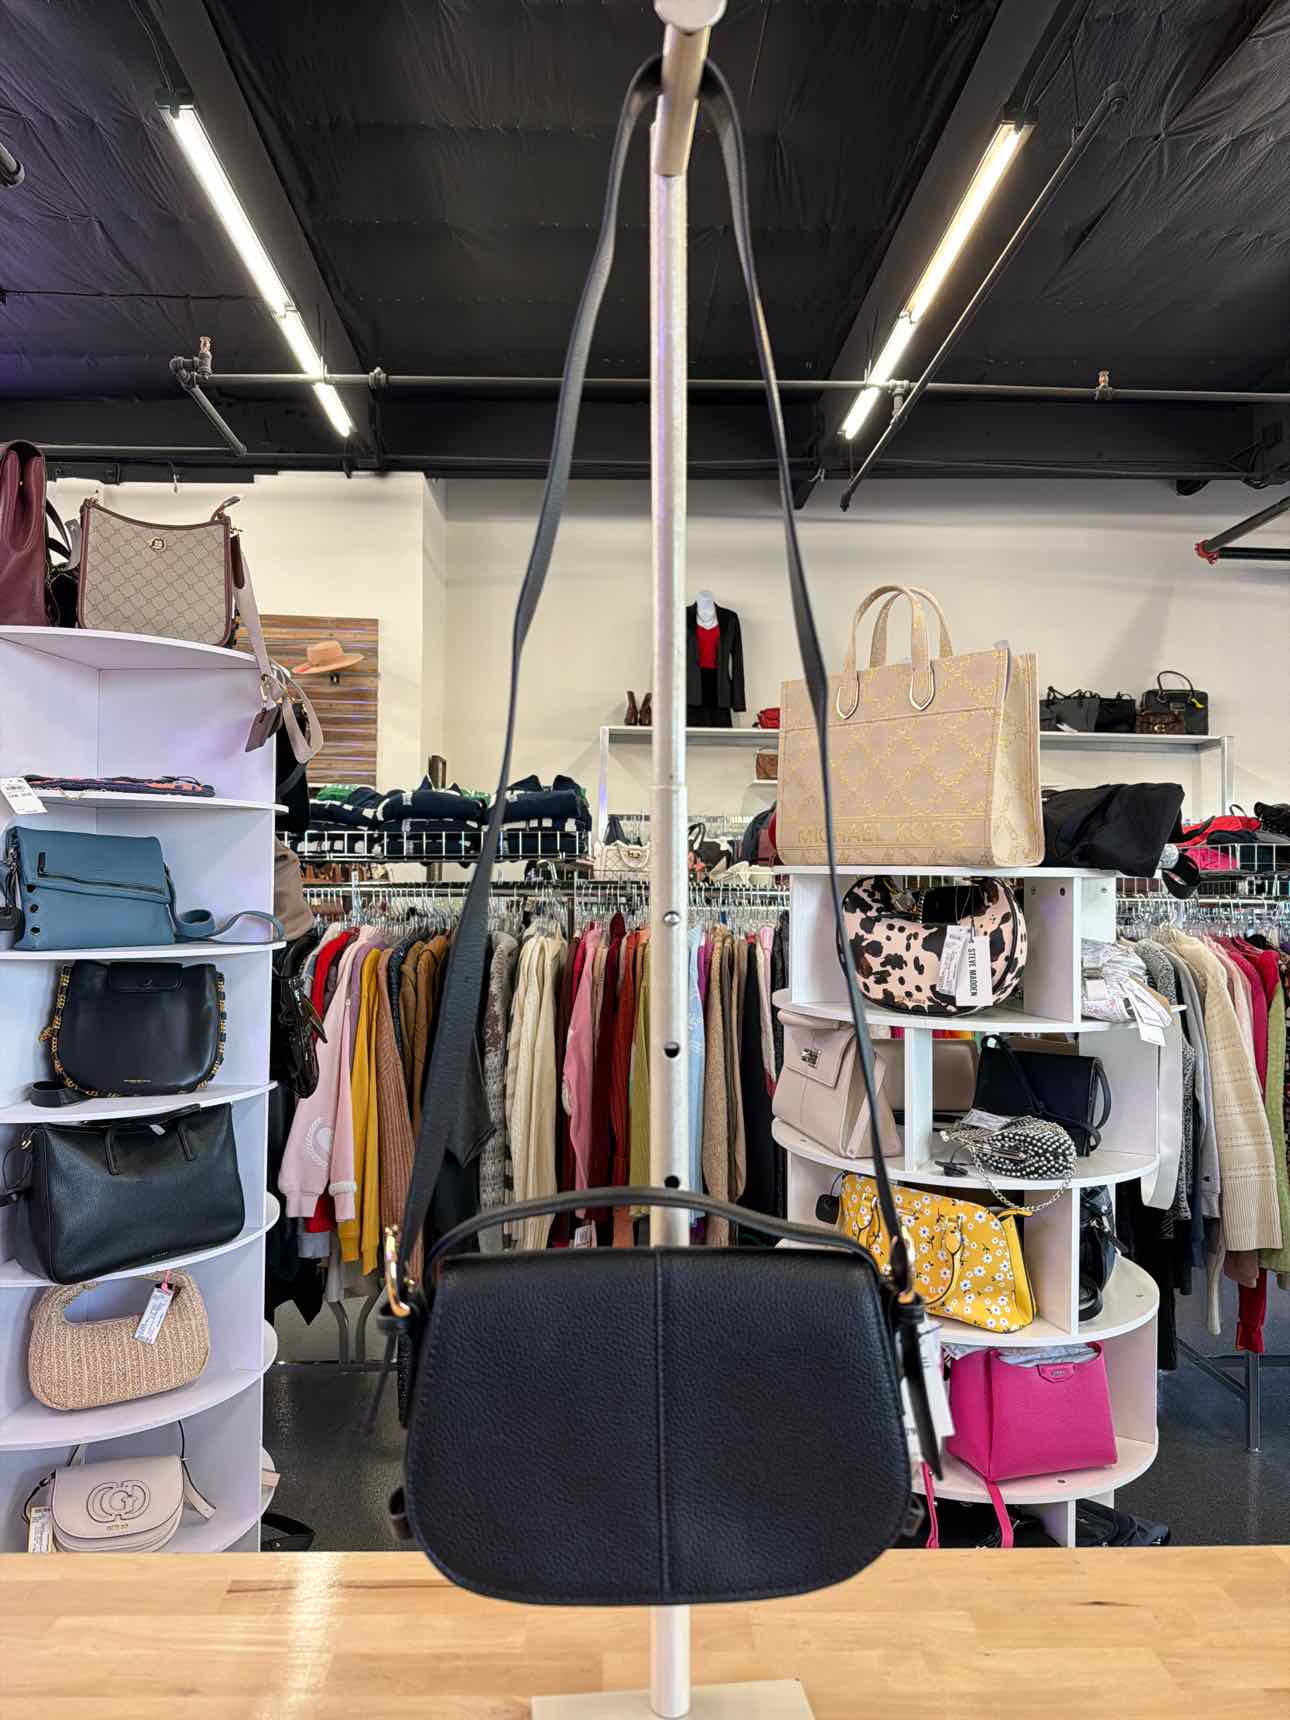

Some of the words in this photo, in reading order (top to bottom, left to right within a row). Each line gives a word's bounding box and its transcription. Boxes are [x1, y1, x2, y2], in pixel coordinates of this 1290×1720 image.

[896, 821, 962, 842] KORS
[967, 948, 977, 968] STEVE
[968, 969, 978, 997] MADDEN
